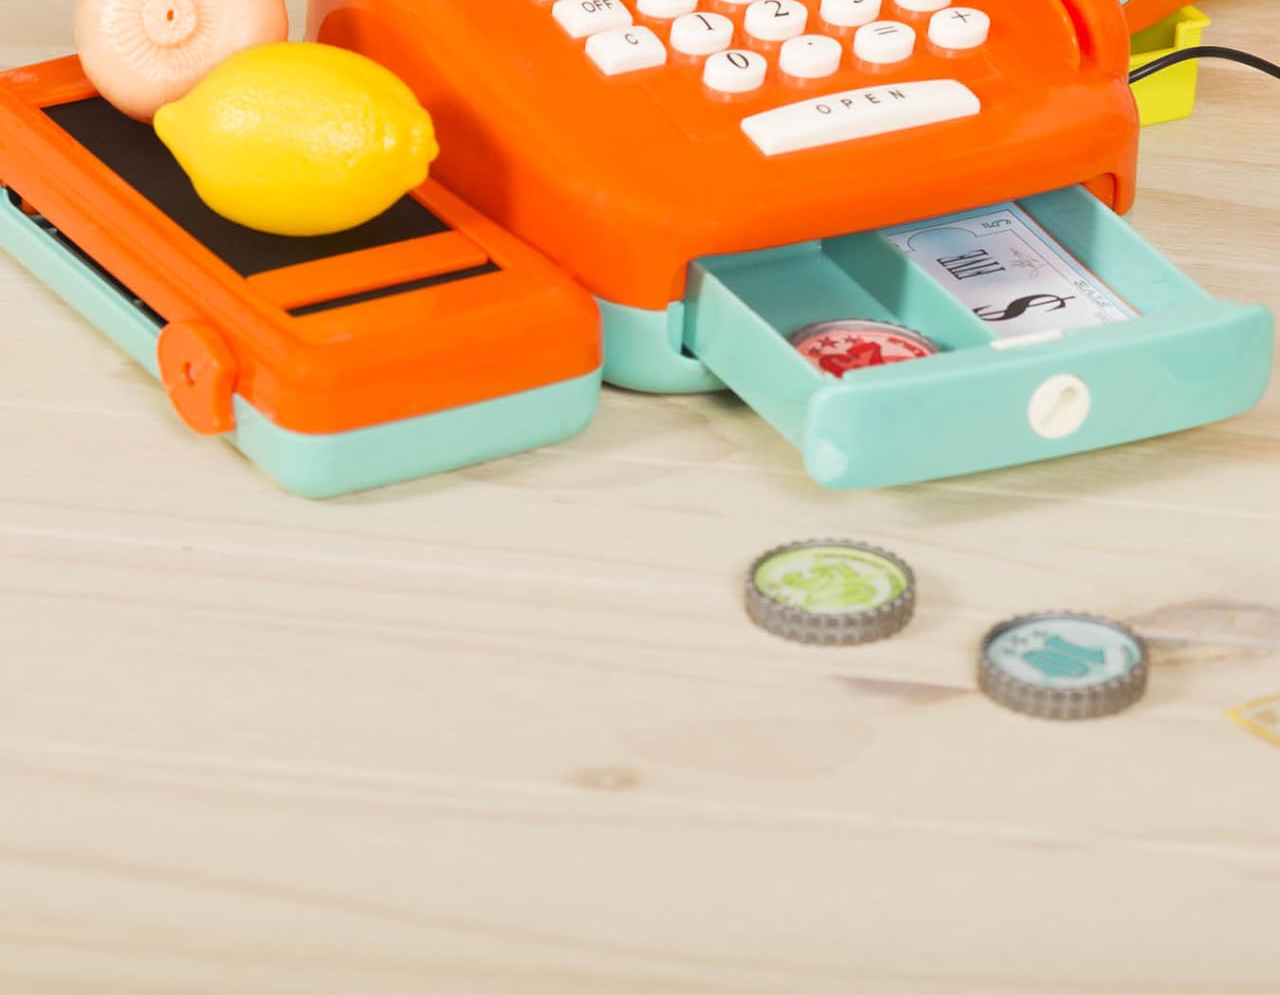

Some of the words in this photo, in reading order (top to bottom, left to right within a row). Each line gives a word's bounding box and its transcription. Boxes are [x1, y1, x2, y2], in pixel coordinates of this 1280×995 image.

[763, 0, 790, 18] 2
[695, 14, 714, 31] 1
[624, 32, 640, 46] C
[726, 52, 750, 70] 0
[815, 89, 907, 115] OPEN
